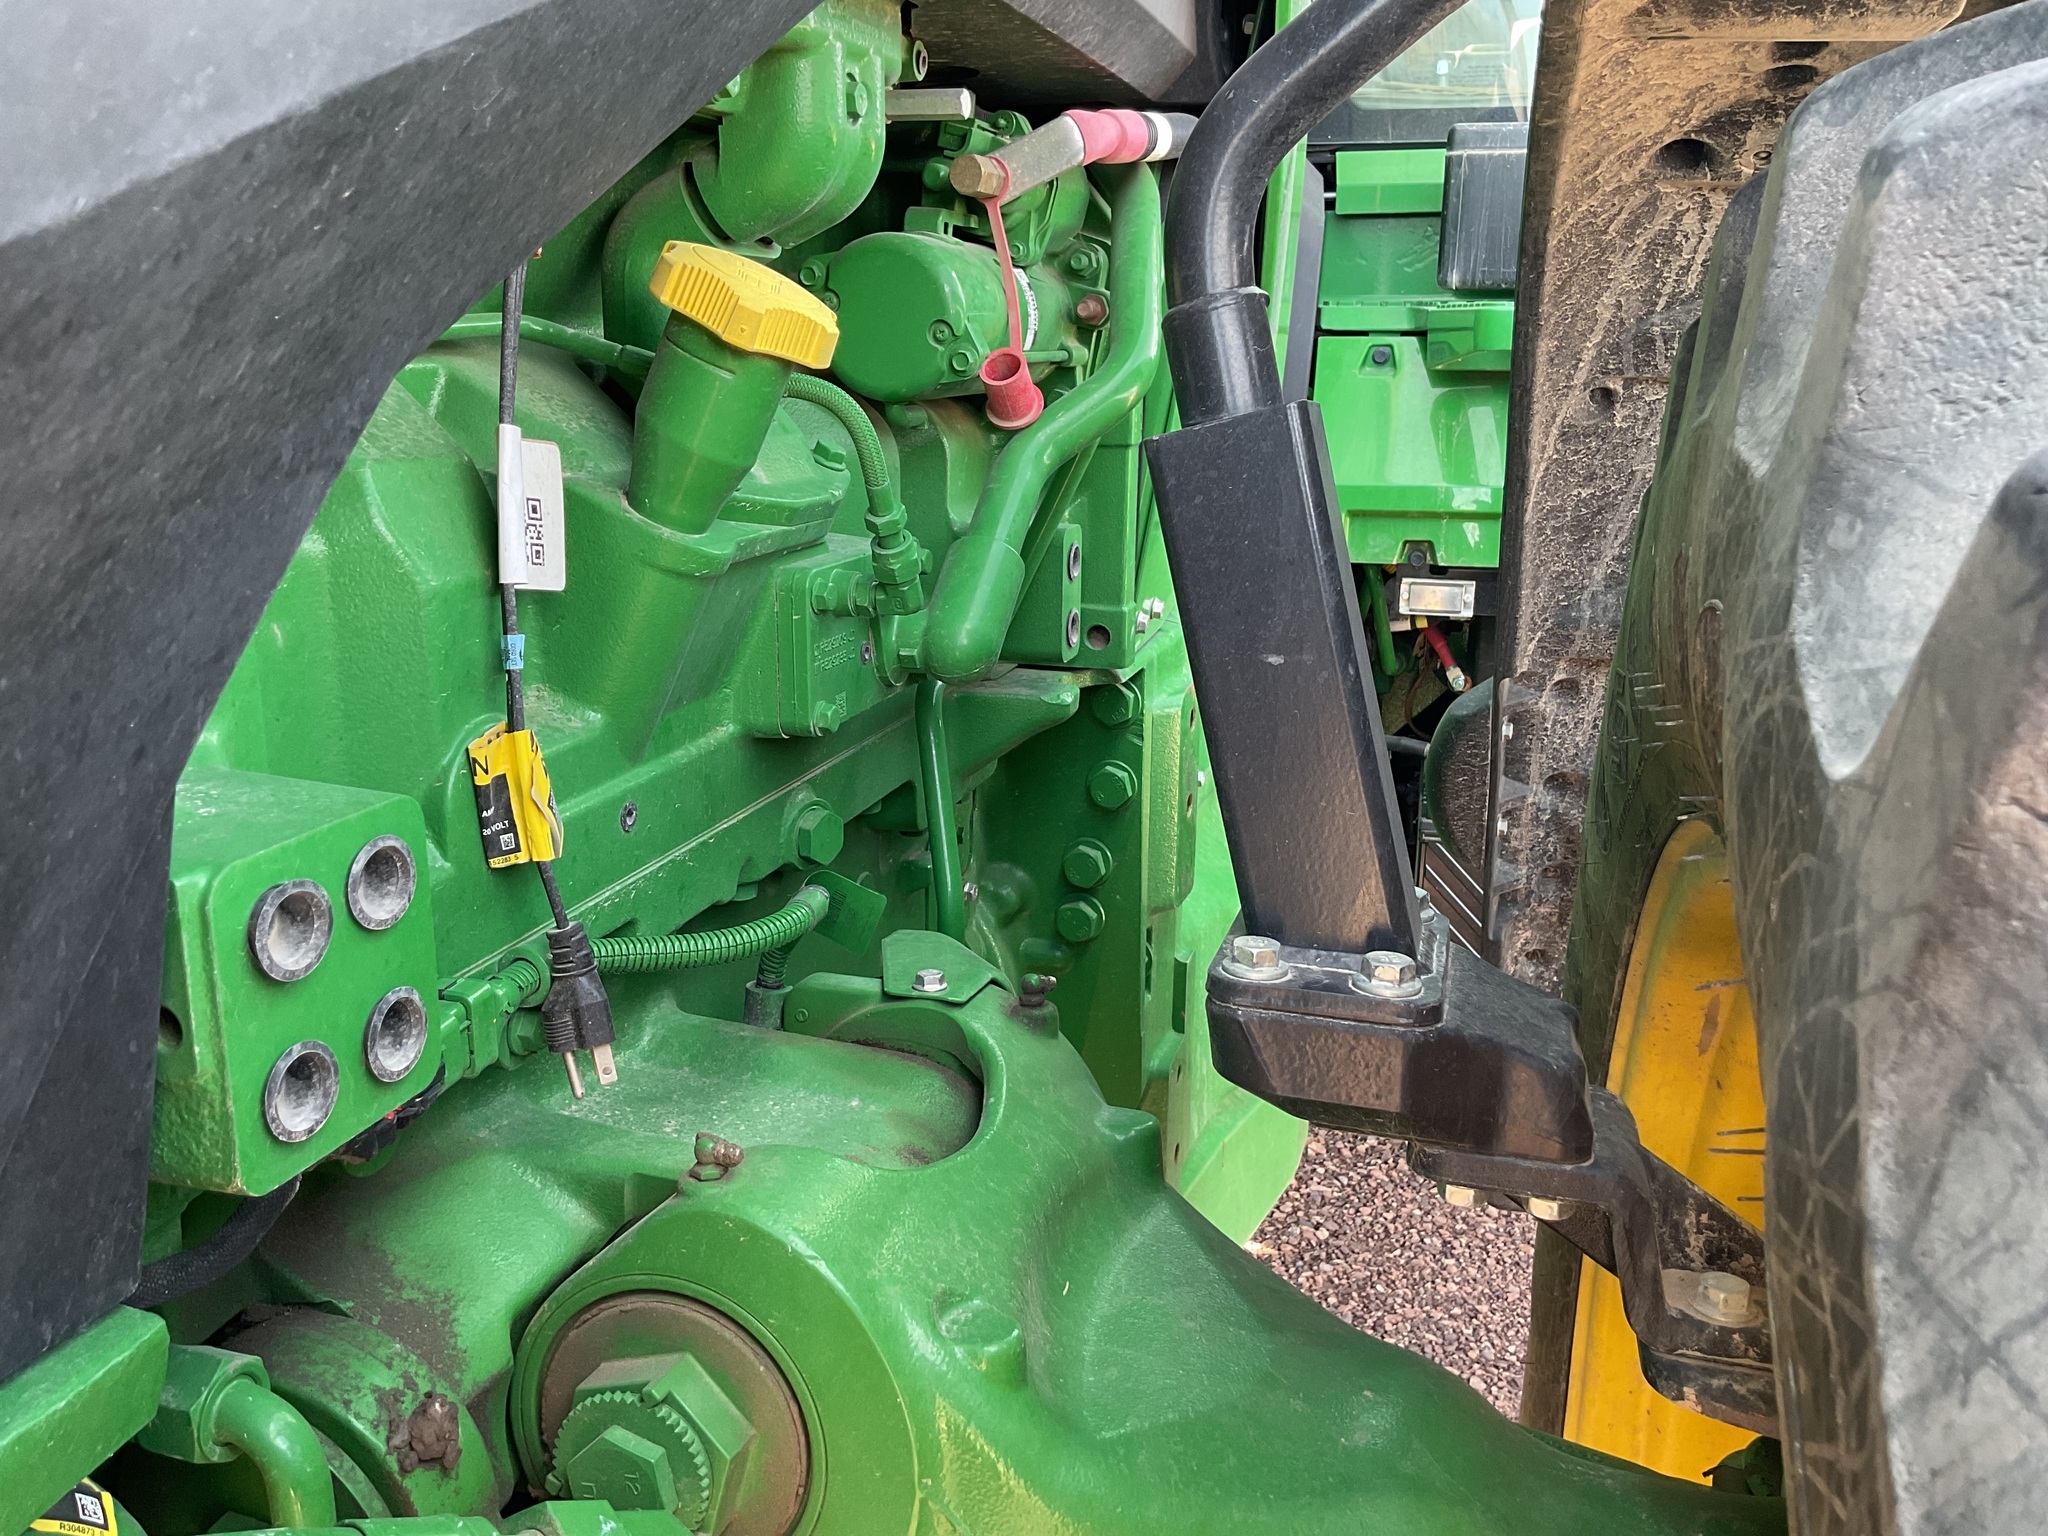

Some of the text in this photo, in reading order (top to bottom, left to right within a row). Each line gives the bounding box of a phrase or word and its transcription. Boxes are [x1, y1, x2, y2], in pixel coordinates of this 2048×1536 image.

[471, 755, 489, 777] N
[490, 820, 509, 832] VOLT
[514, 853, 519, 861] S
[59, 1522, 95, 1536] R304873
